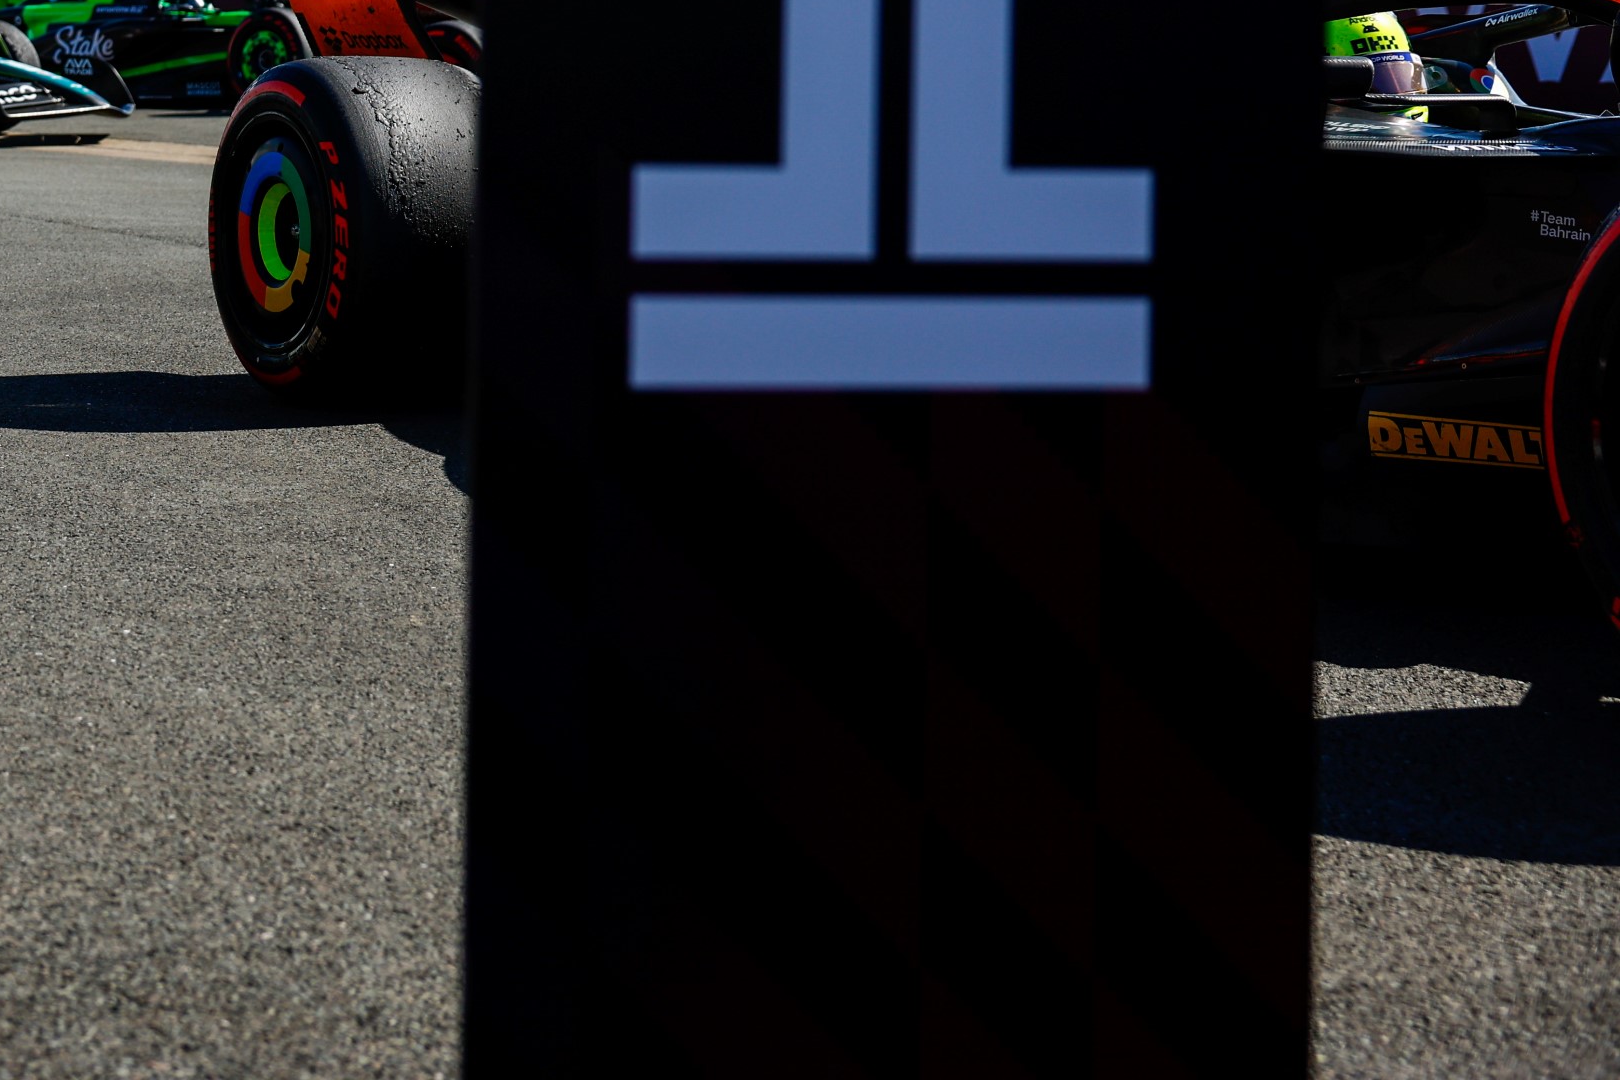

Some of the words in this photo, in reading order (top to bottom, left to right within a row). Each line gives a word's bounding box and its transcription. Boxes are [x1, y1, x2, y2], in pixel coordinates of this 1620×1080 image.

[1499, 7, 1539, 24] Airwallex
[52, 25, 116, 65] Stake
[341, 30, 407, 52] Dropbox
[1350, 36, 1399, 54] OKX
[64, 58, 93, 69] AVA
[317, 140, 340, 166] P
[1530, 209, 1576, 226] #Team
[1539, 224, 1591, 242] Bahrain
[324, 177, 351, 321] ZERO
